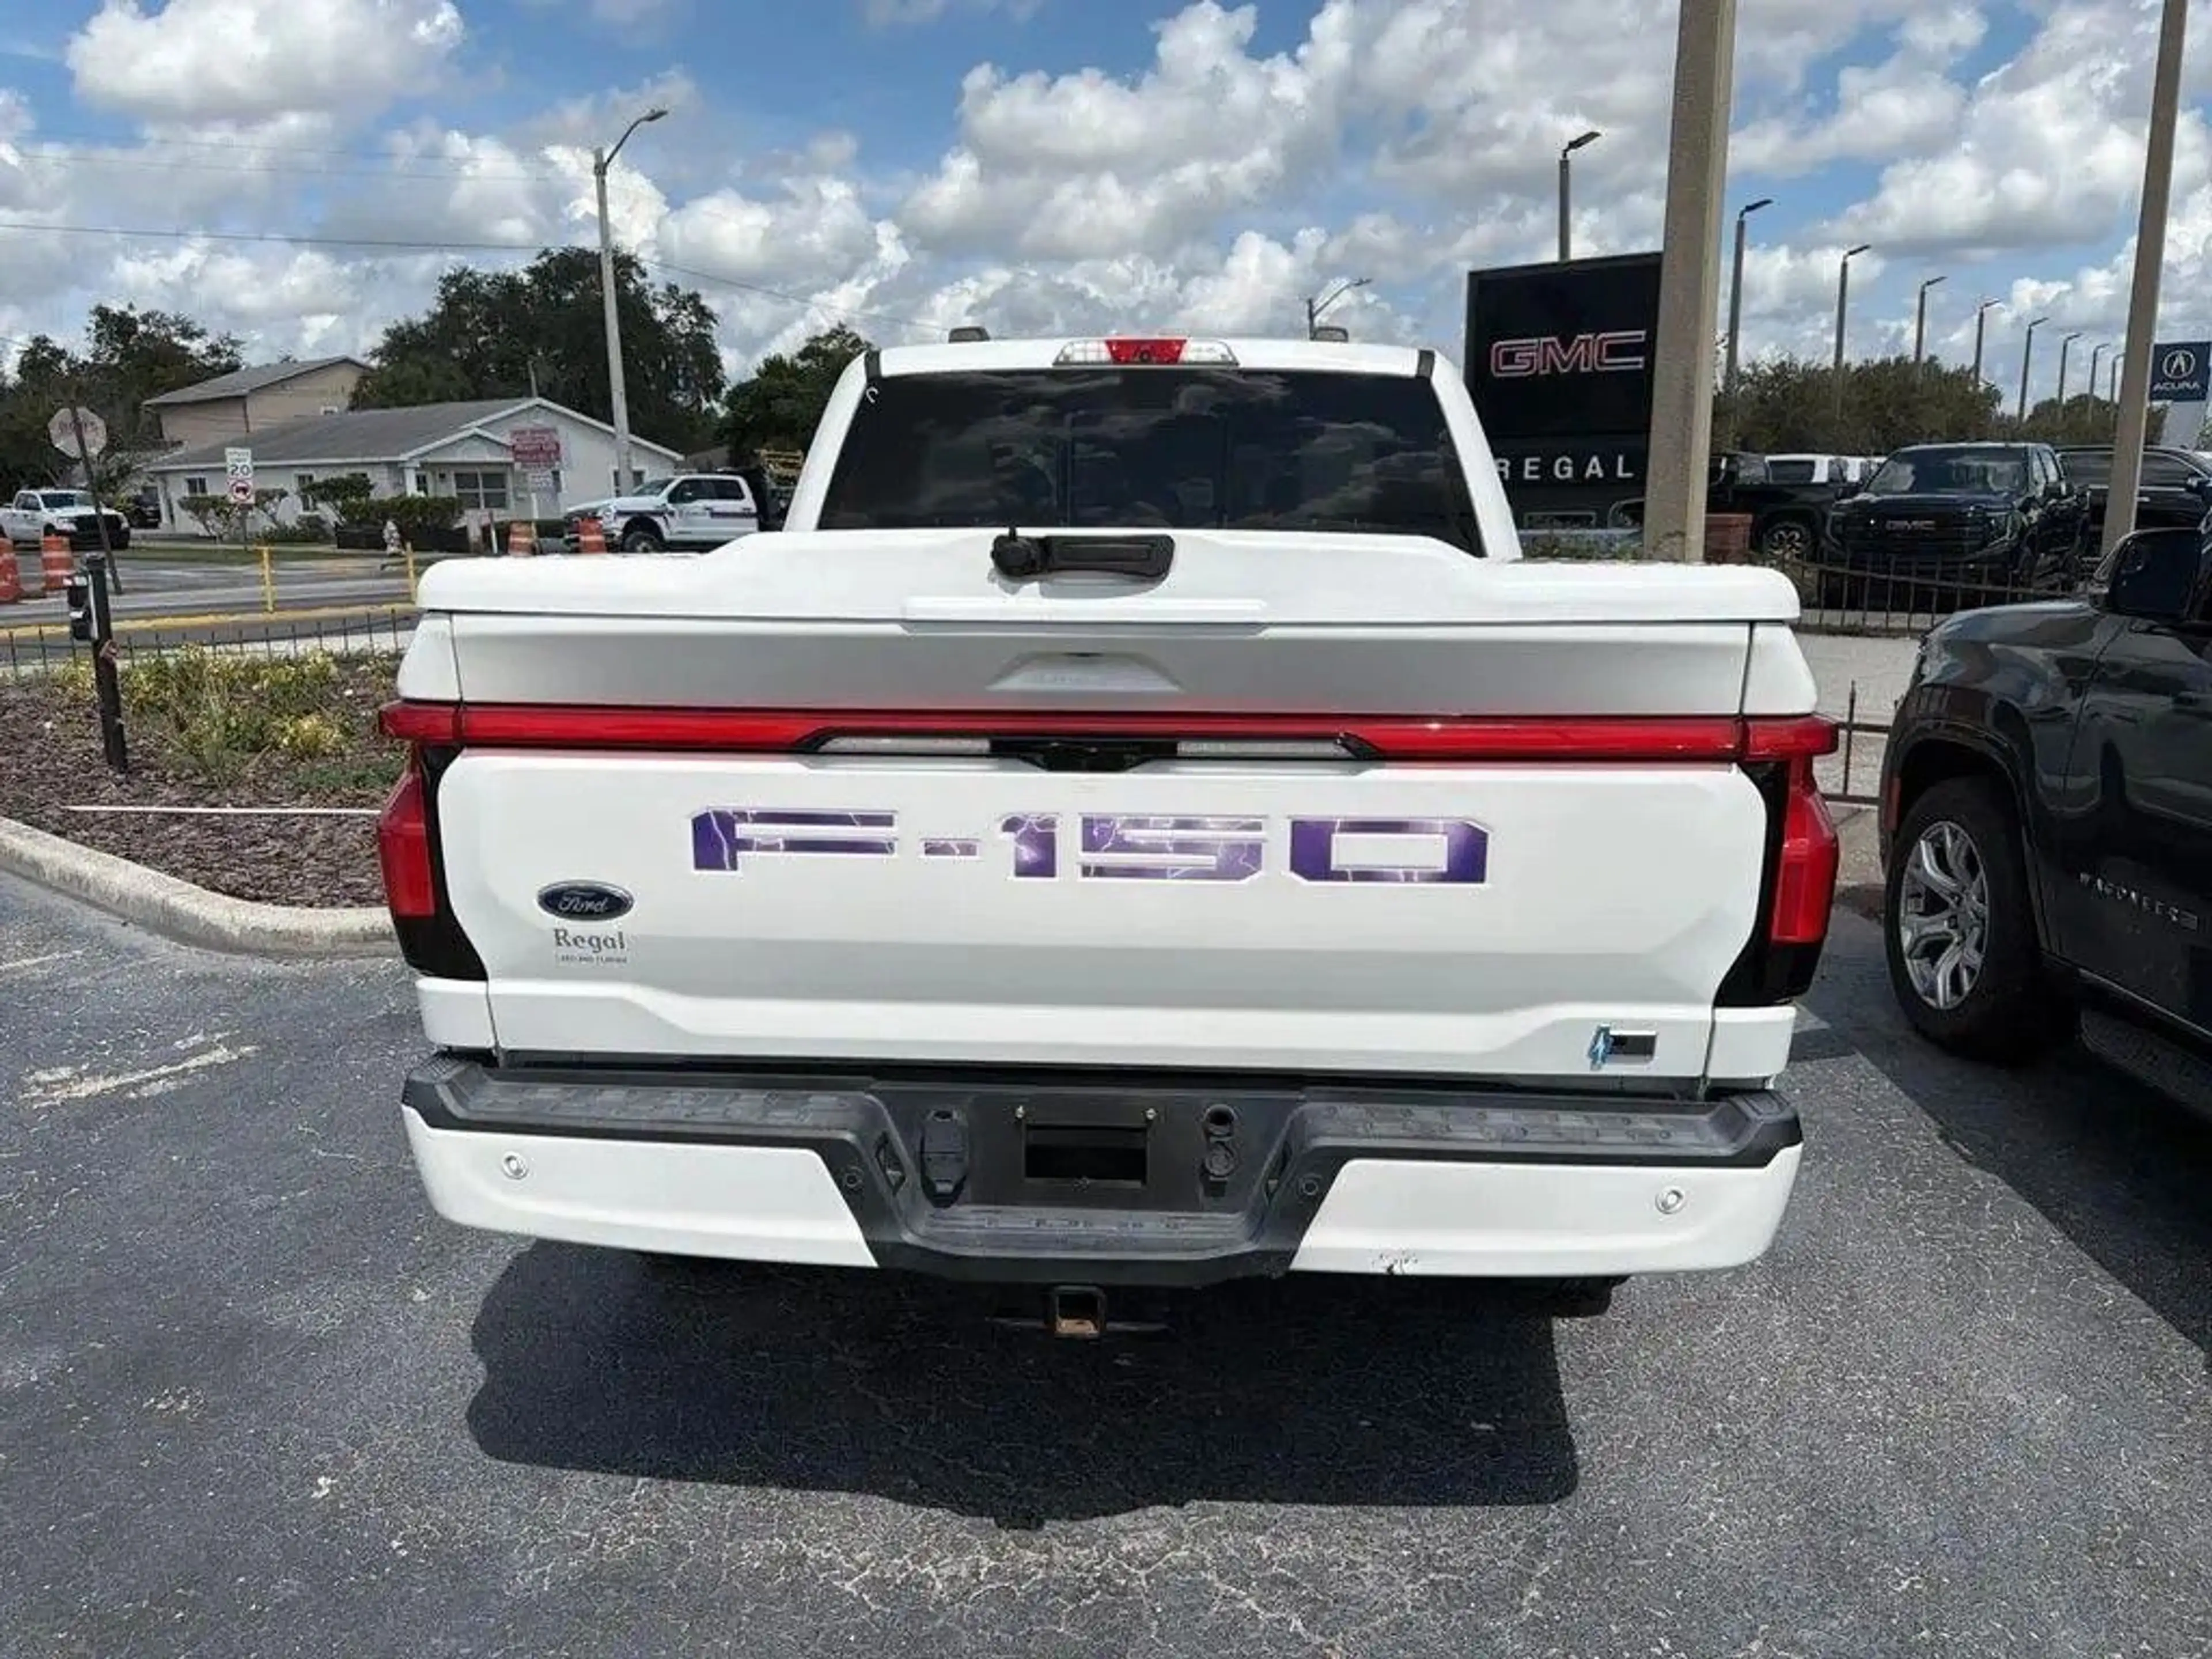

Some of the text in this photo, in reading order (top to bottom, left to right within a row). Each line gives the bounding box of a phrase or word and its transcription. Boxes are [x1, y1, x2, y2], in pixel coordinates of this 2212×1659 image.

[1490, 330, 1646, 377] GMC
[2153, 381, 2200, 391] ACURA
[230, 464, 252, 476] 20
[1496, 456, 1635, 479] REGAL
[692, 806, 1491, 885] F-150
[558, 890, 609, 913] Ford
[554, 928, 626, 953] Regal
